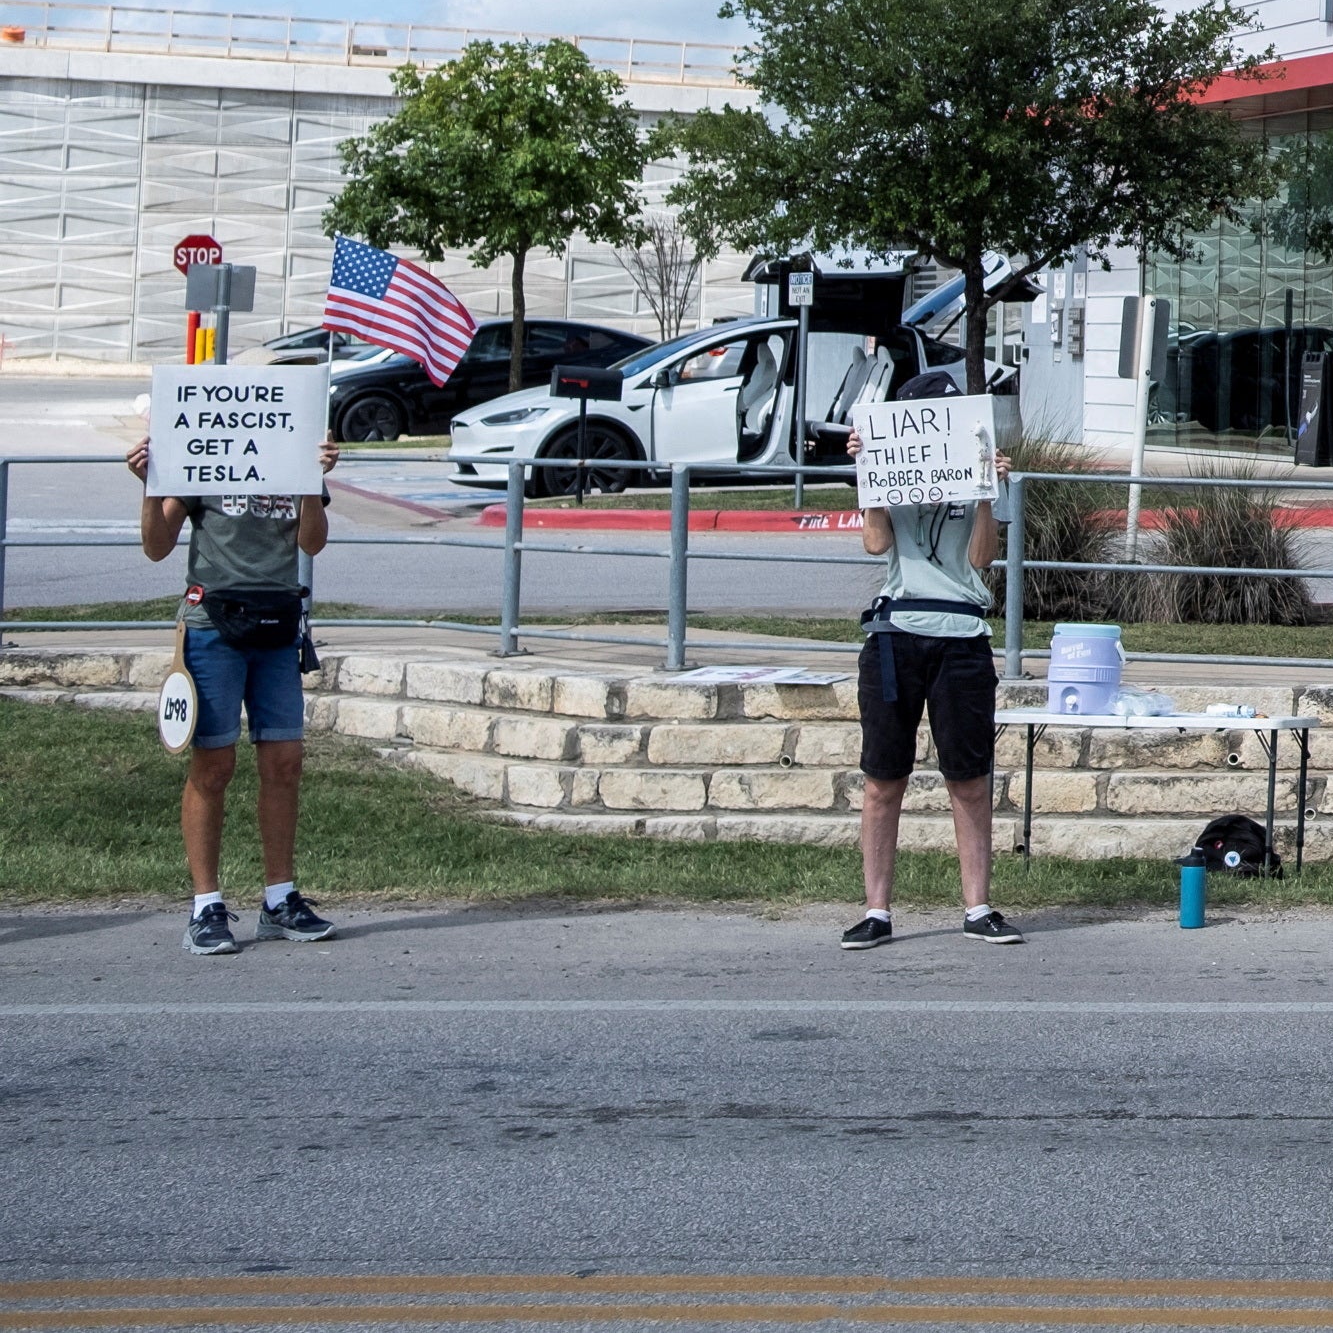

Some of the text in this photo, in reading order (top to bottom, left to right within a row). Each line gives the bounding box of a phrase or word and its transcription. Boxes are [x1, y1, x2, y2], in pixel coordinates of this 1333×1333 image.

[176, 247, 220, 265] STOP
[177, 385, 284, 402] IF YOU'RE
[174, 412, 295, 432] A FASCIST,
[868, 407, 951, 441] LIAR!
[187, 439, 259, 455] GET A
[183, 466, 266, 482] TESLA.
[930, 467, 974, 484] BARON
[799, 513, 864, 530] FIRE LAN
[164, 697, 187, 722] 8647
